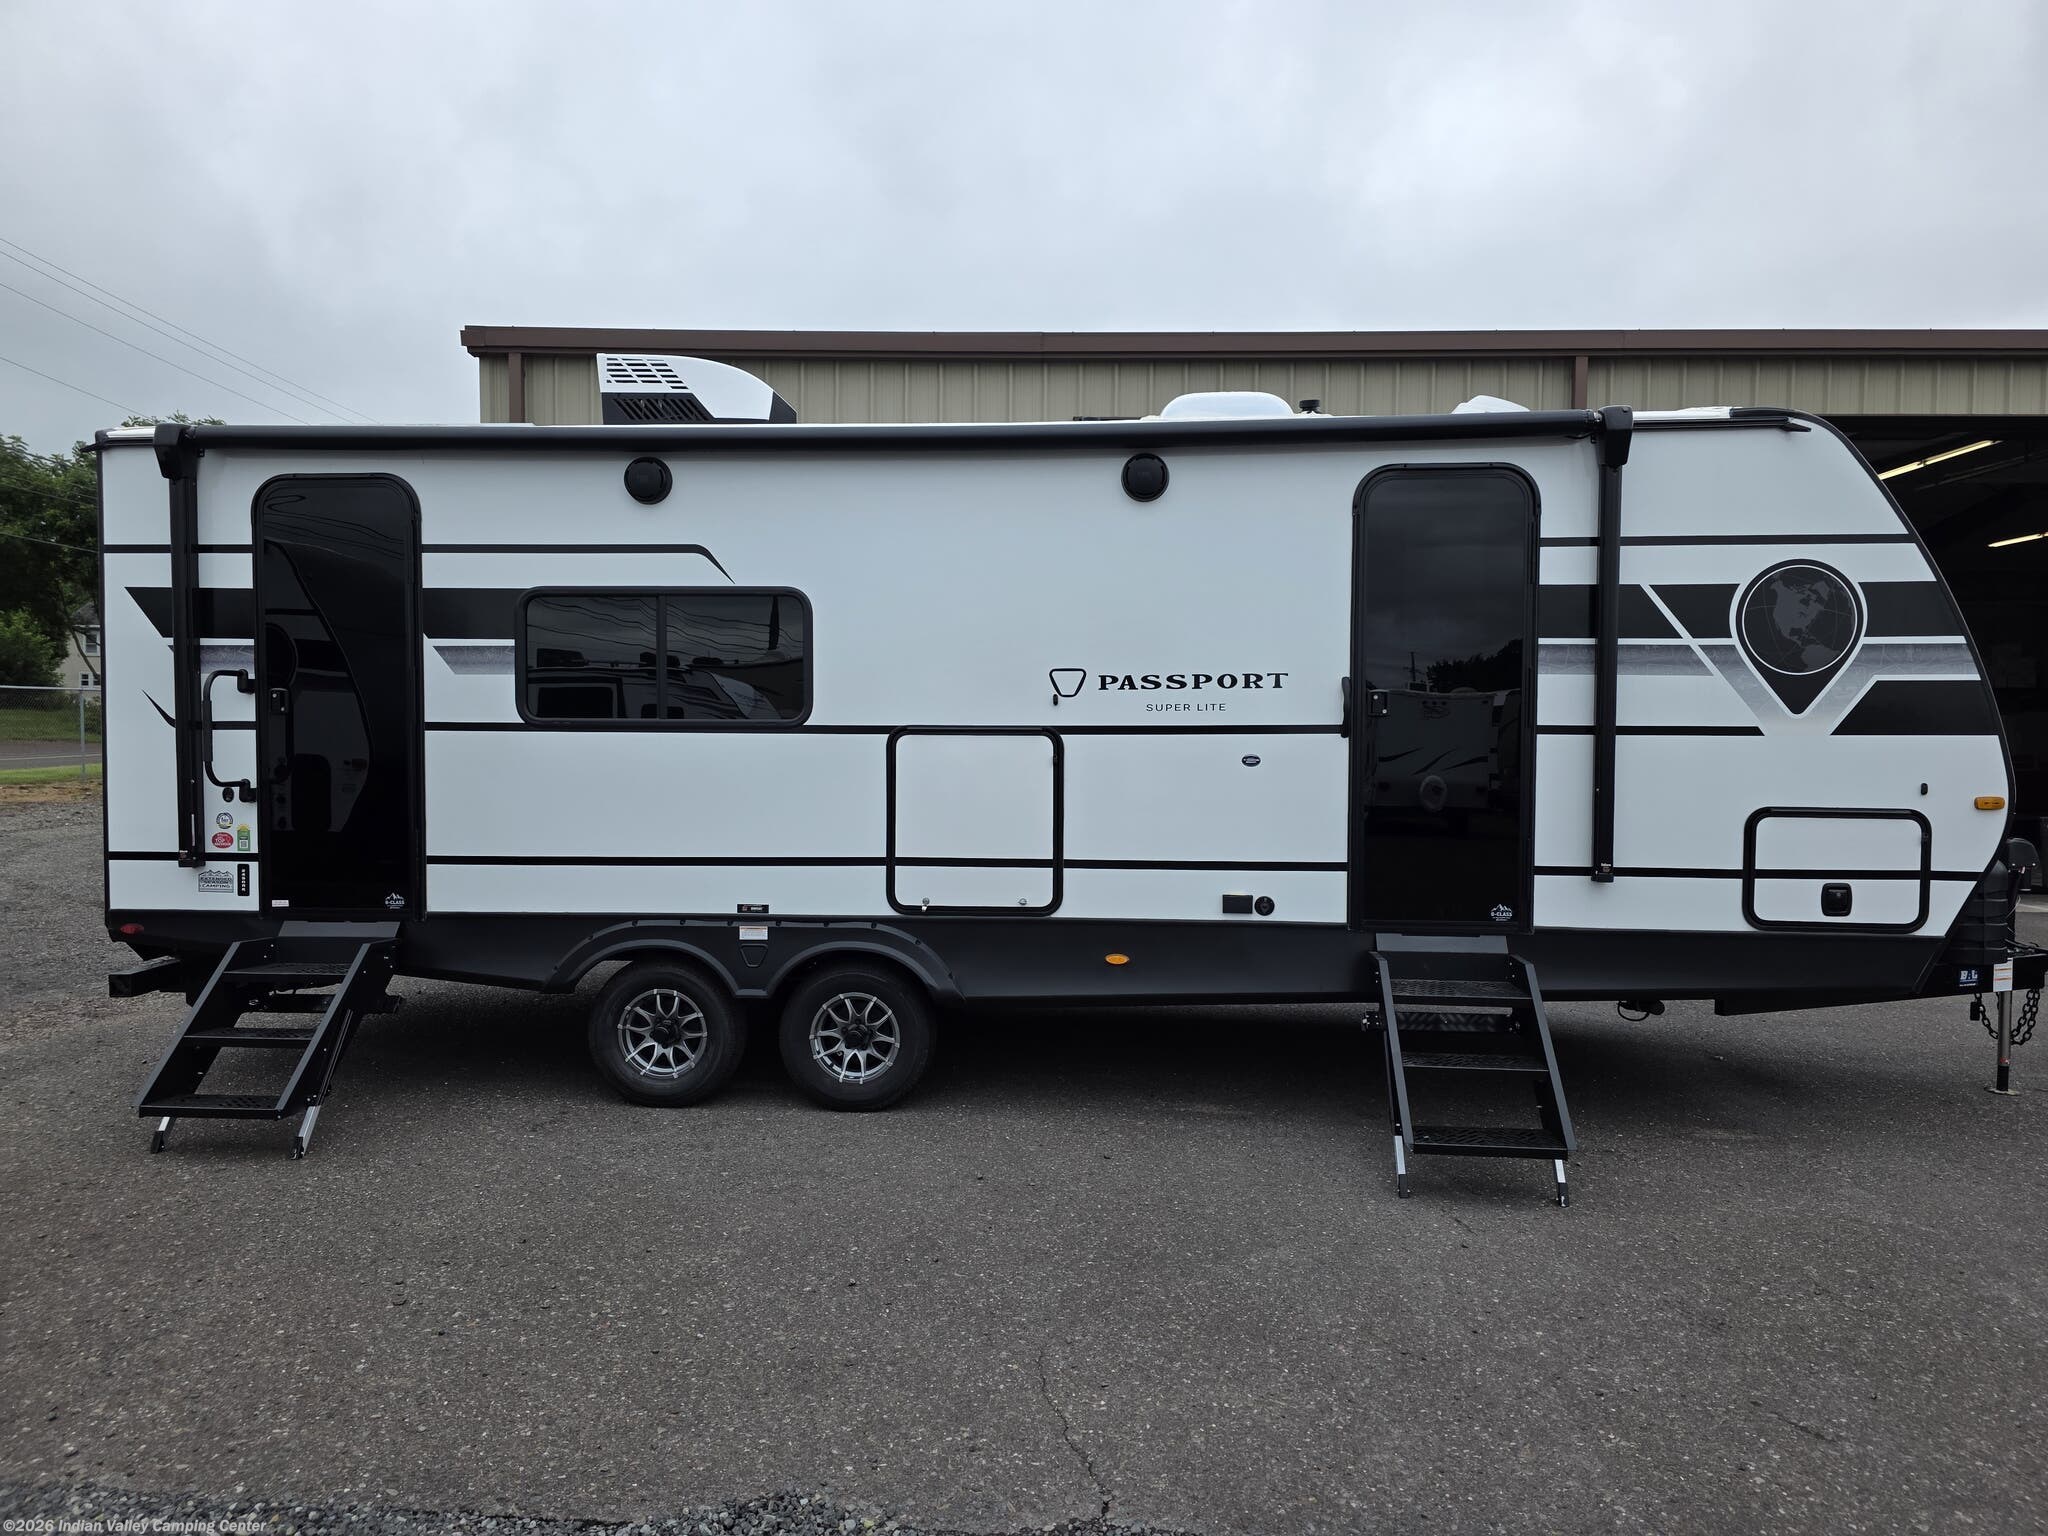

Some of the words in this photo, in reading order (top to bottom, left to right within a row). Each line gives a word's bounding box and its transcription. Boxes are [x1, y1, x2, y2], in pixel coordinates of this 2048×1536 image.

[1097, 672, 1289, 691] PASSPORT
[1146, 703, 1191, 712] SUPER
[1197, 703, 1227, 712] LITE
